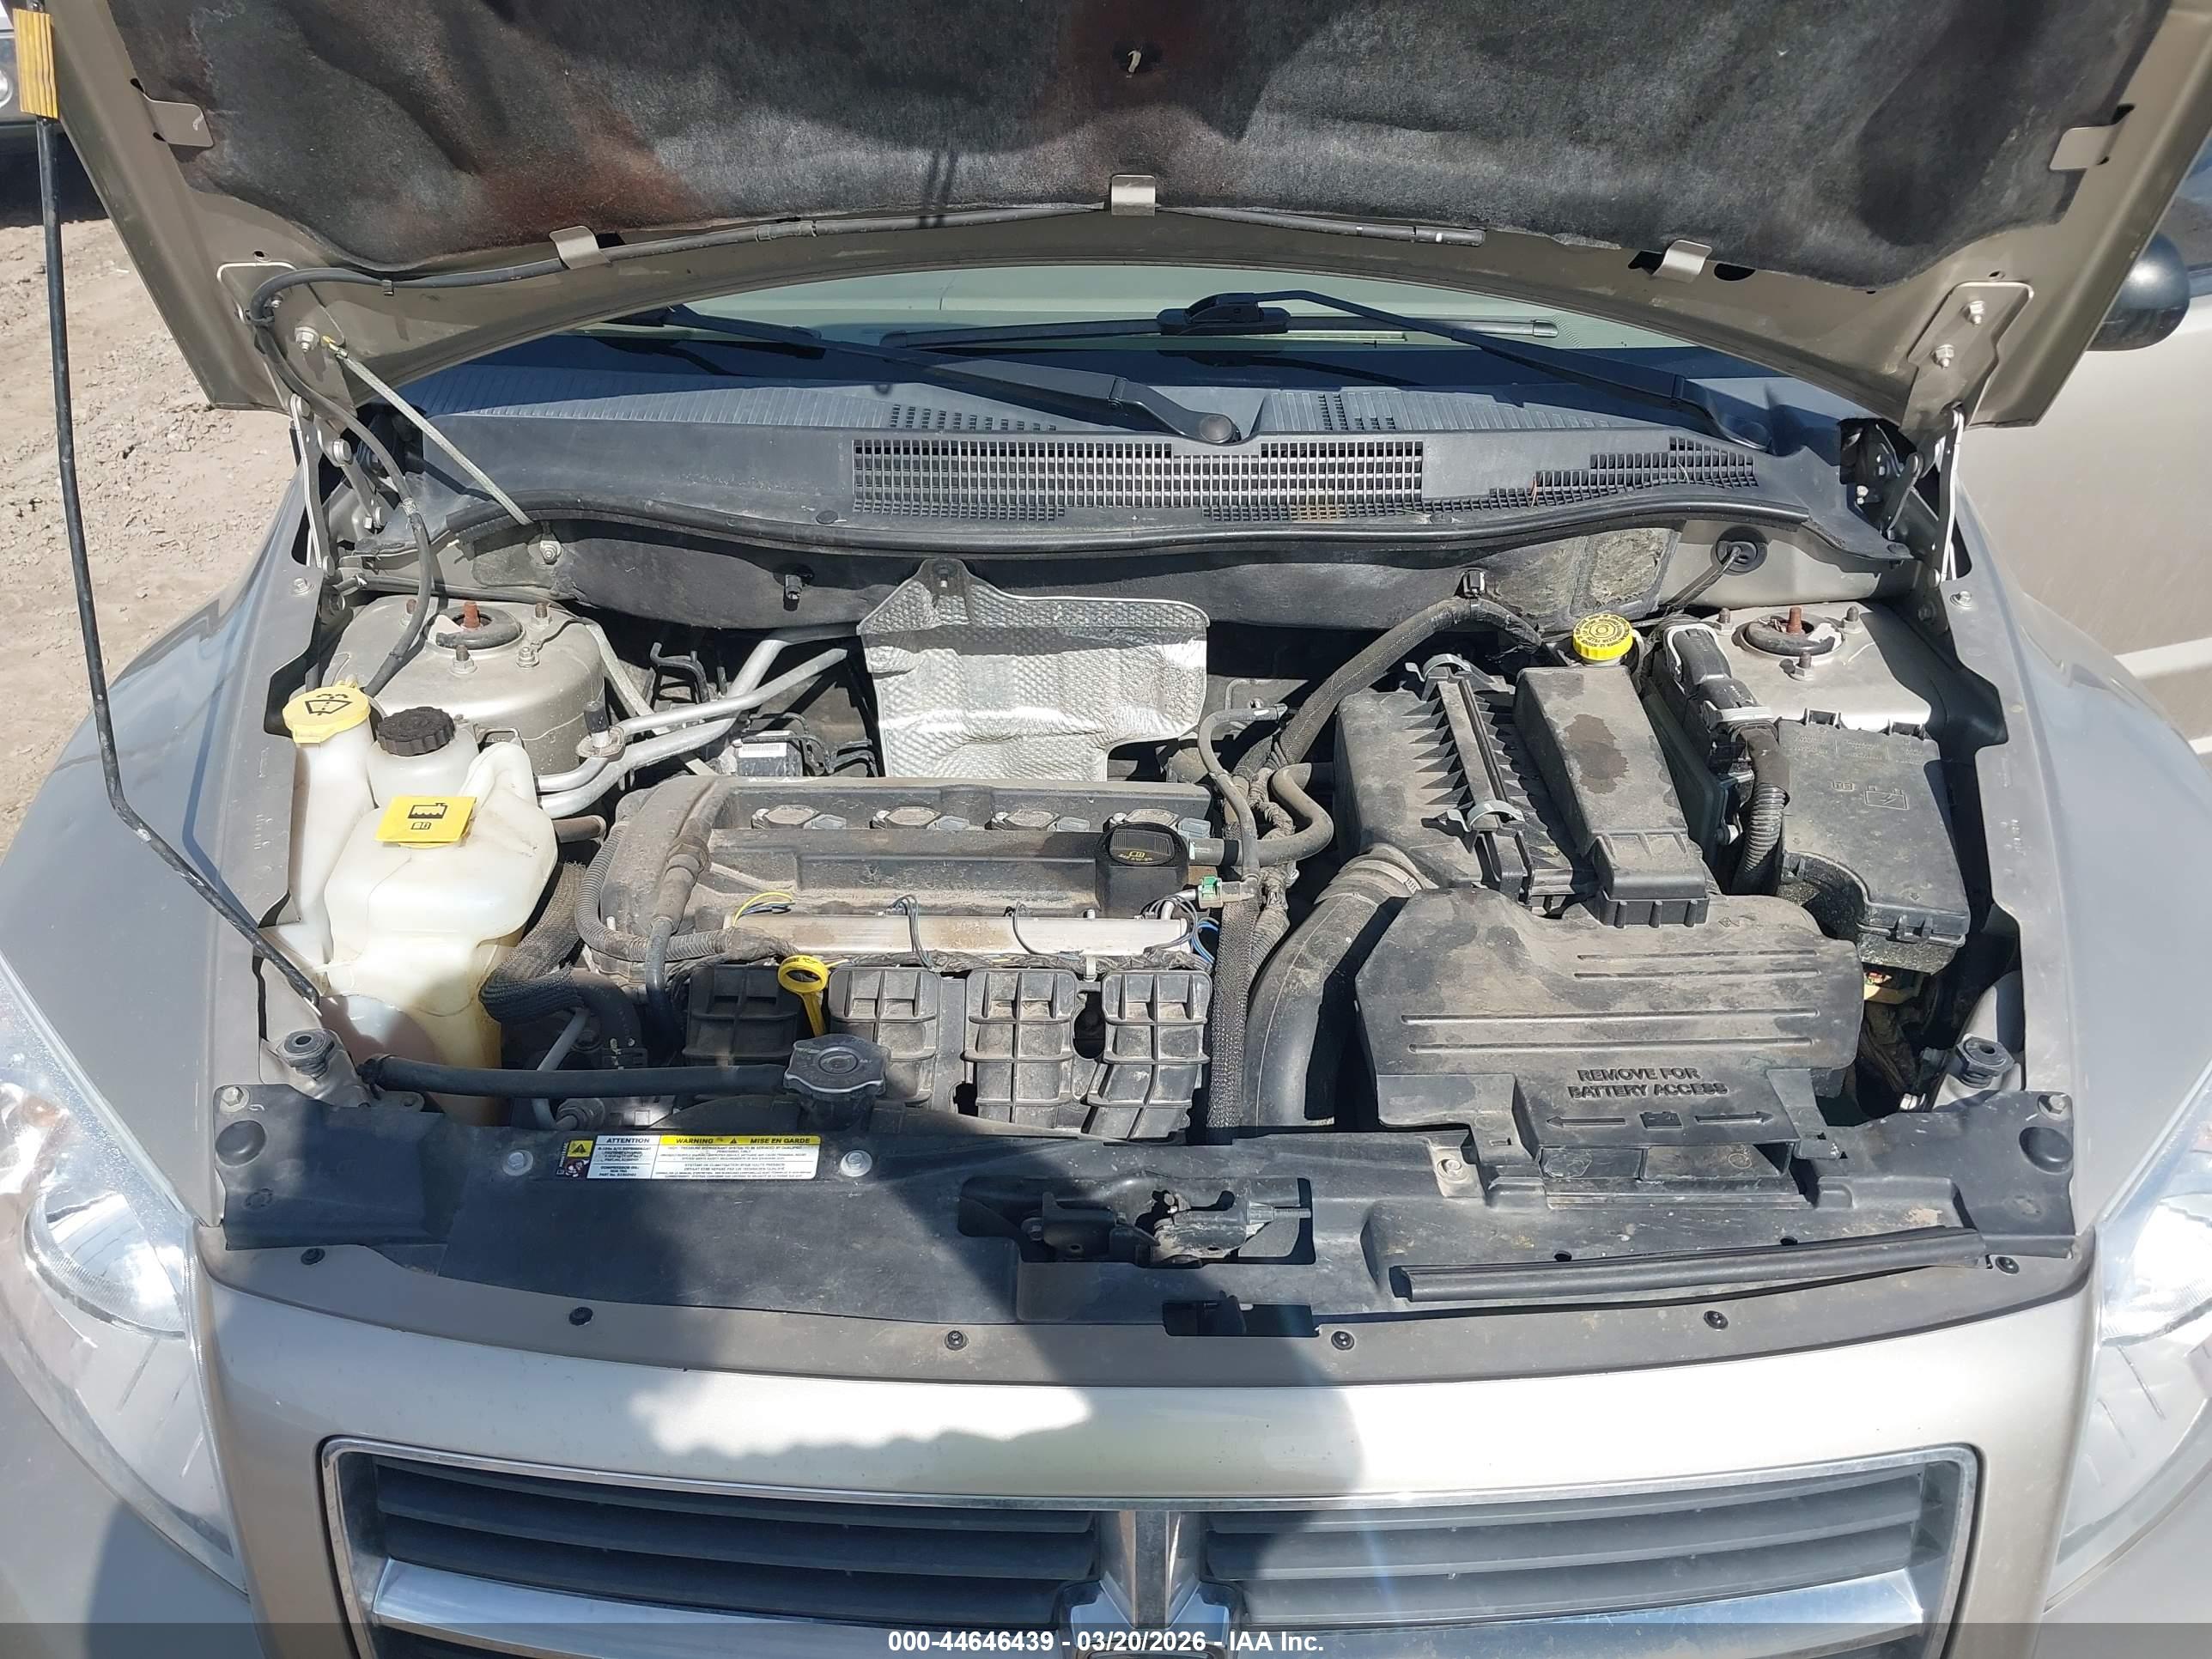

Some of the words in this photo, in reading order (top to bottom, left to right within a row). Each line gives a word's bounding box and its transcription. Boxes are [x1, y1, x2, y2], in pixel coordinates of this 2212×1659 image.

[1577, 1068, 1658, 1081] REMOVE
[1659, 1067, 1701, 1079] FOR
[1567, 1084, 1648, 1098] BATTERY
[1654, 1083, 1728, 1096] ACCESS
